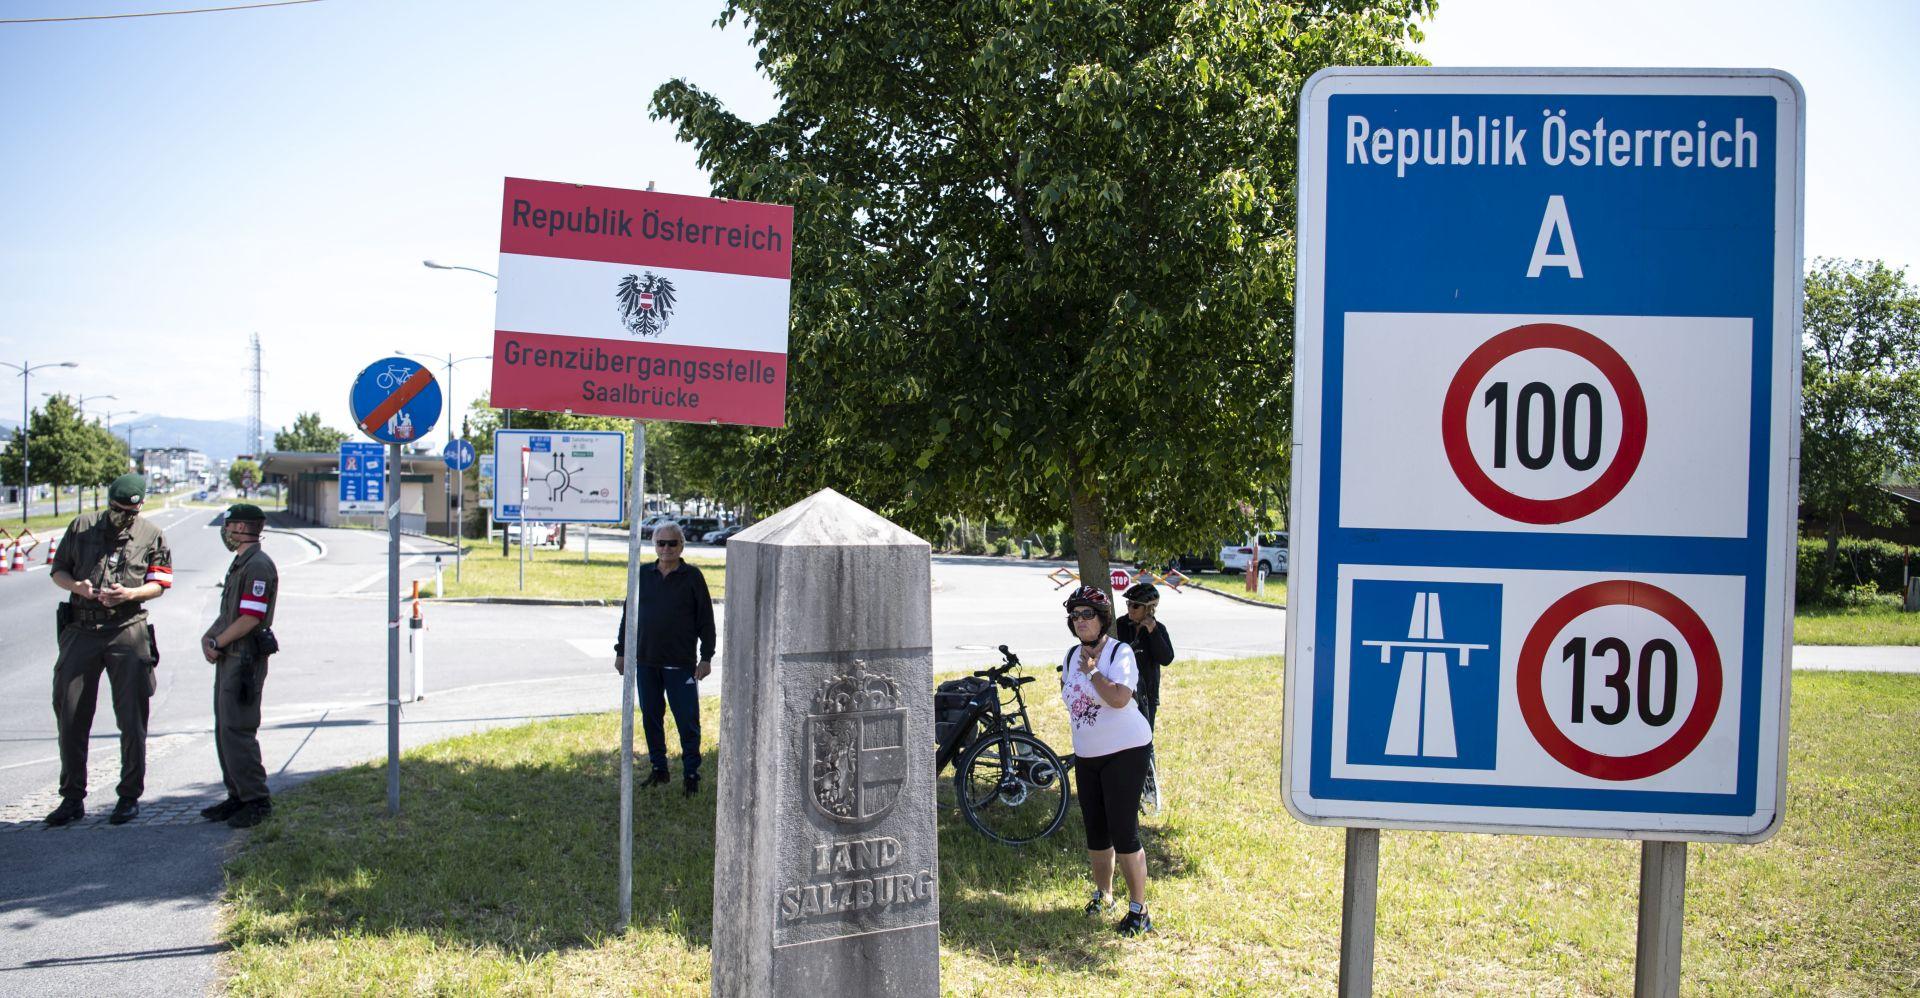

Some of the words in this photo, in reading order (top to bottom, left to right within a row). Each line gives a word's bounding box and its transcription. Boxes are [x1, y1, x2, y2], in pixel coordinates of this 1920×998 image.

[1346, 115, 1527, 178] Republik
[1542, 108, 1758, 168] Österreich
[512, 199, 633, 237] Republik
[641, 208, 783, 251] Österreich
[1525, 195, 1584, 278] A
[504, 340, 776, 383] Grenzübergangsstelle
[582, 380, 699, 408] Saalbrücke
[1484, 381, 1603, 471] 100
[1110, 576, 1129, 586] STOP
[1562, 636, 1678, 727] 130
[814, 836, 901, 875] LAND
[781, 869, 933, 920] SALZBURG
